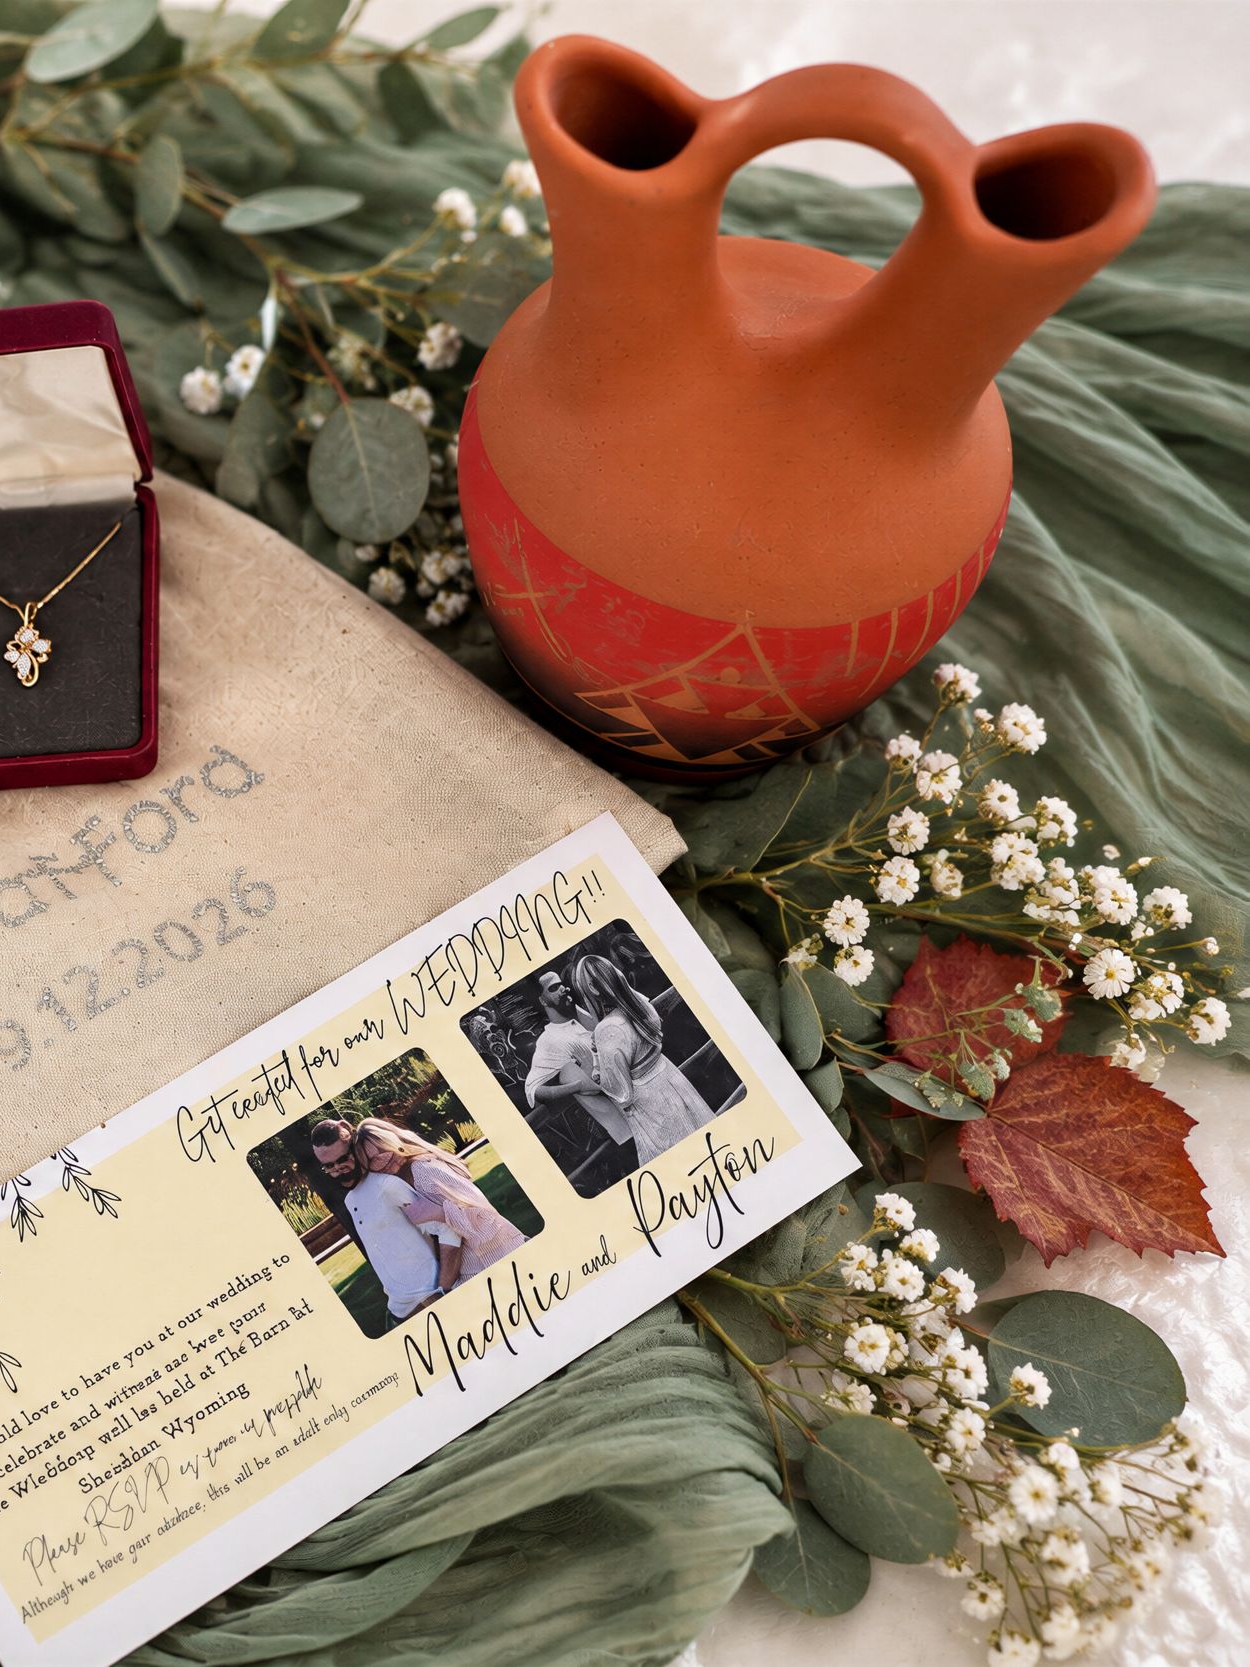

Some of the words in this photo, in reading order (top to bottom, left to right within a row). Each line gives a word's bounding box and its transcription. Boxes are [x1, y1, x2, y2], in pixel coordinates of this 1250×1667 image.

[298, 1045, 340, 1102] for
[402, 1260, 571, 1397] Maddie
[582, 1235, 617, 1277] and
[626, 1131, 775, 1258] Payton
[20, 1401, 60, 1426] love
[60, 1387, 80, 1401] to
[79, 1362, 121, 1389] have
[123, 1340, 155, 1369] you
[157, 1325, 175, 1342] at
[178, 1308, 203, 1329] our
[206, 1266, 272, 1310] wedding
[271, 1254, 291, 1268] to
[199, 1364, 216, 1381] at
[247, 1320, 291, 1349] Barn
[70, 1404, 101, 1432] and
[160, 1382, 251, 1440] Wyoming
[253, 1456, 271, 1471] be
[275, 1445, 290, 1459] an
[83, 1456, 170, 1546] RSVP
[77, 1570, 96, 1586] we
